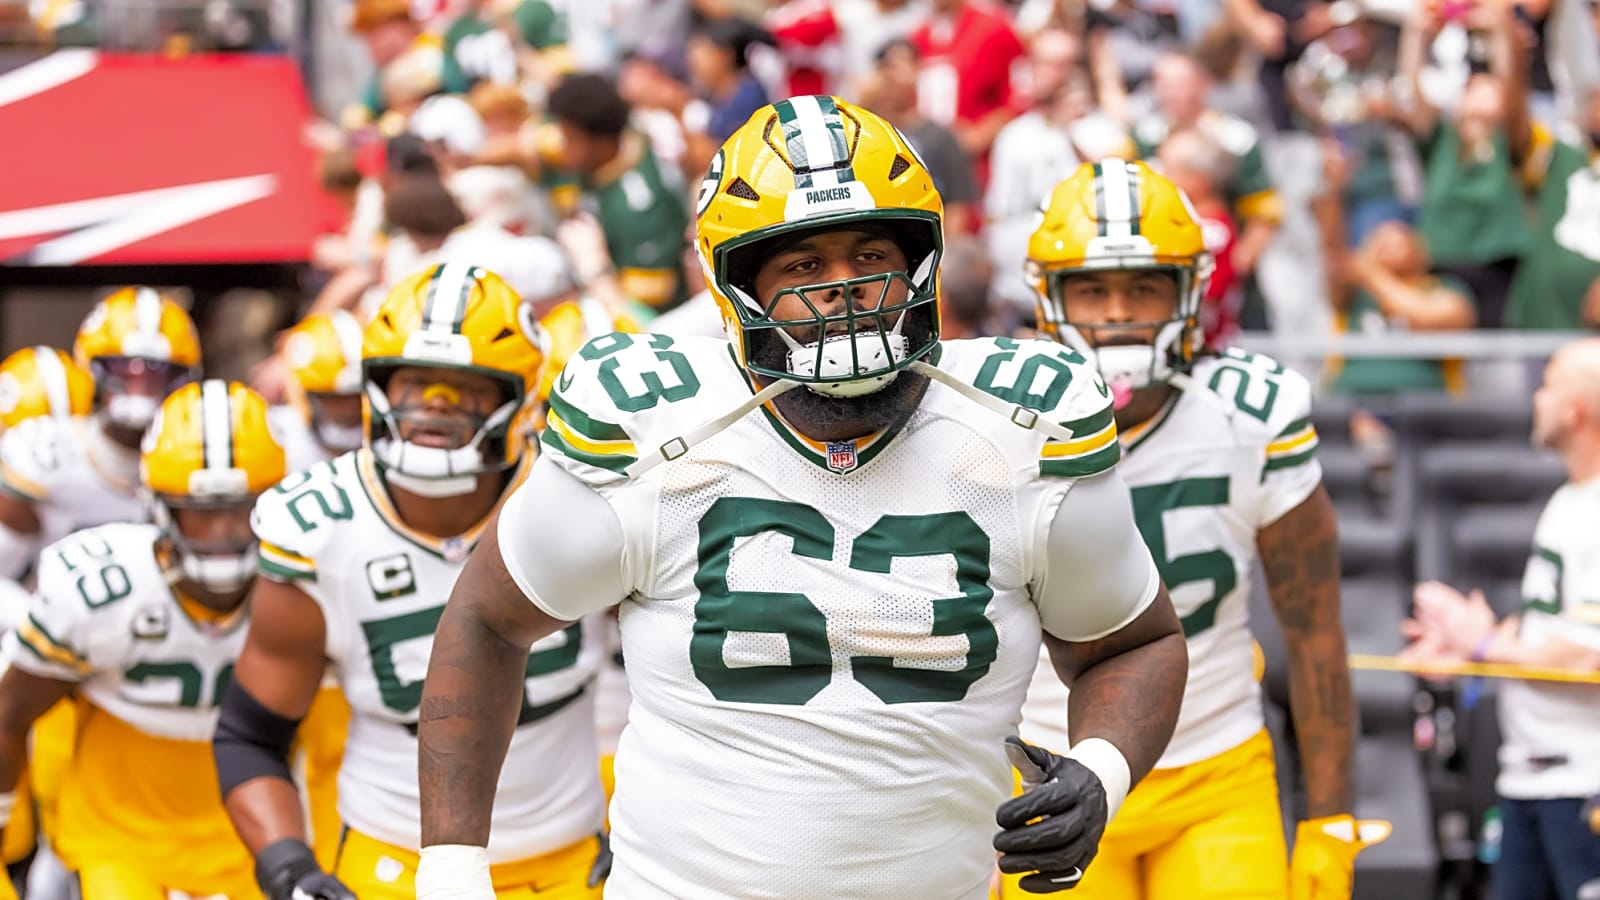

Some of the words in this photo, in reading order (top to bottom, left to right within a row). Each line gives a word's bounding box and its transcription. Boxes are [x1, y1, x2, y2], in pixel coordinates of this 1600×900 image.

[805, 186, 852, 205] PACKERS
[831, 452, 853, 468] NFL
[369, 553, 413, 594] C
[689, 496, 999, 706] 63
